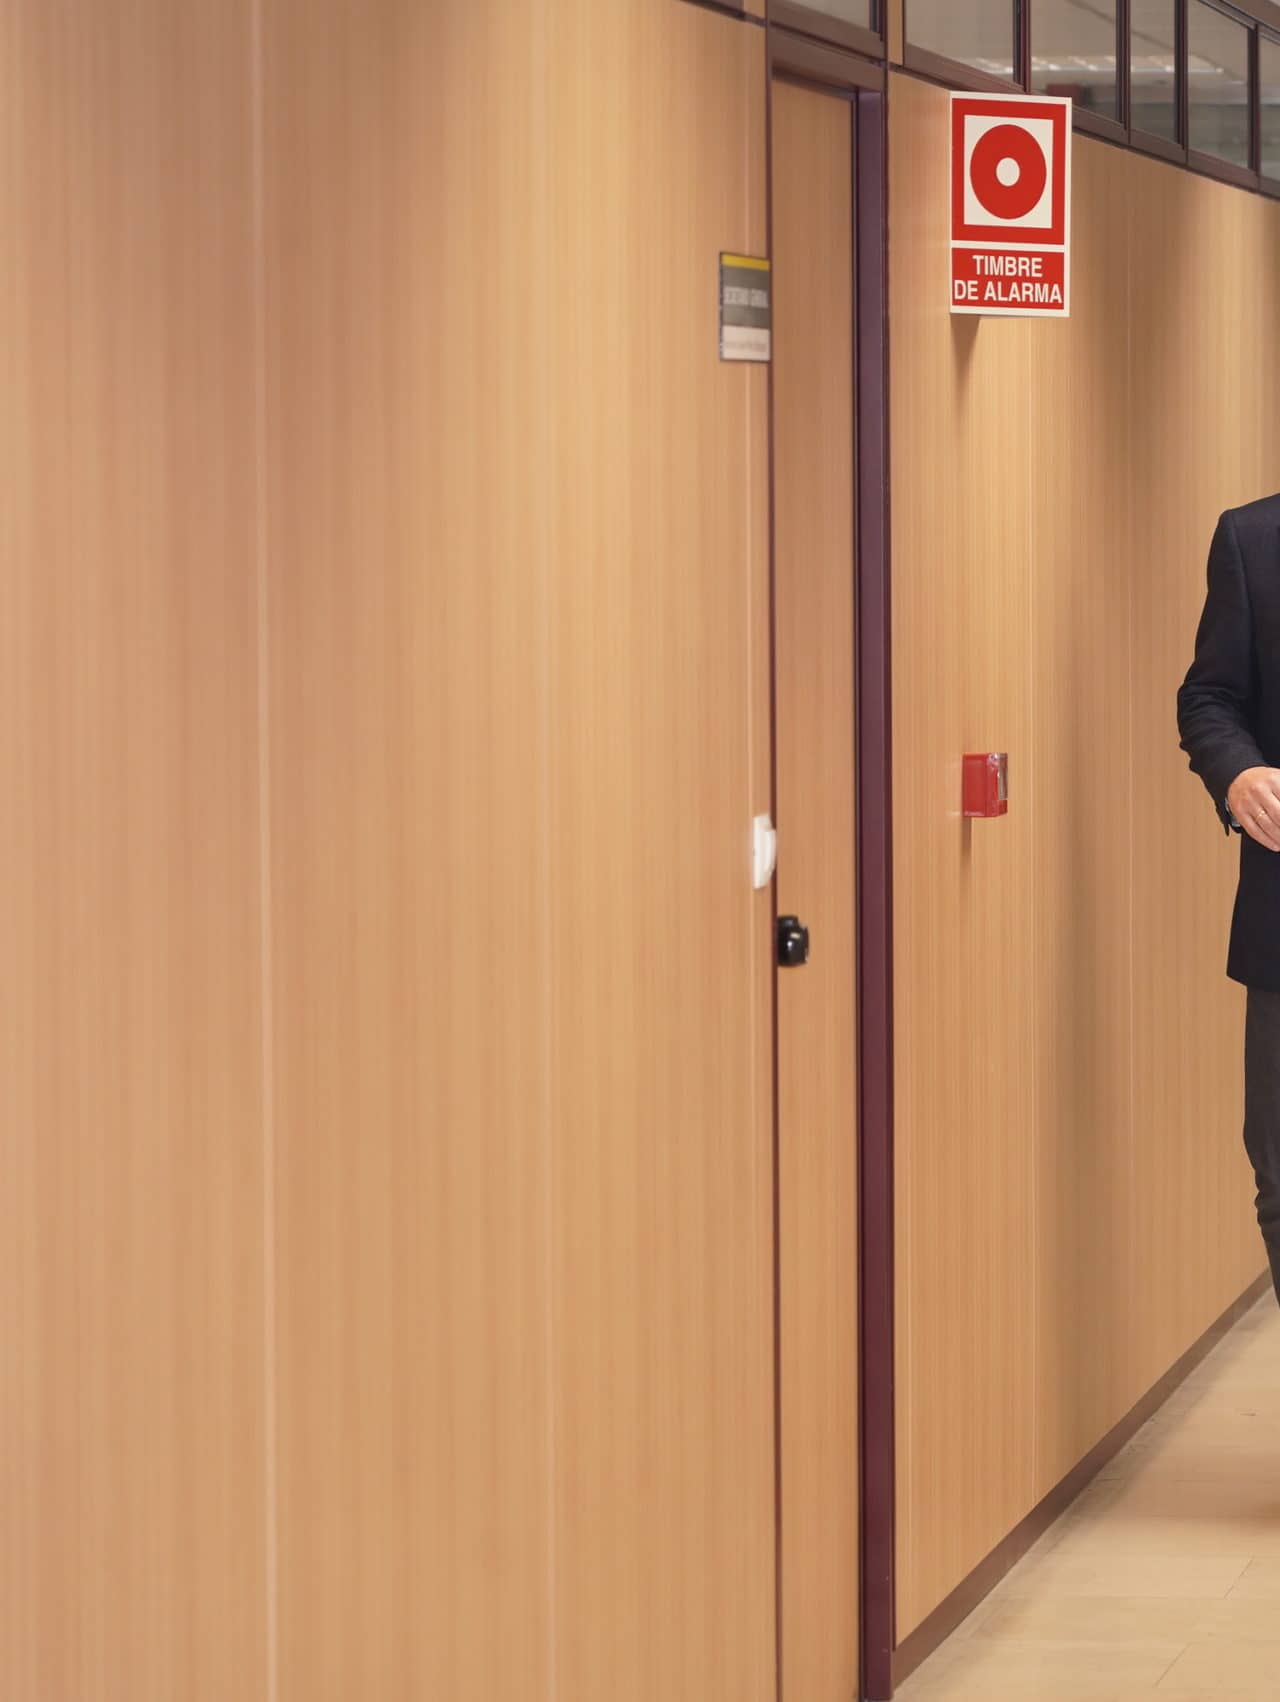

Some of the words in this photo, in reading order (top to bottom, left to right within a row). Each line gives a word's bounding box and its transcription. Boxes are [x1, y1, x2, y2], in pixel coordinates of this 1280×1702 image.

[972, 254, 1043, 278] TIMBRE
[954, 280, 979, 300] DE
[983, 281, 1062, 303] ALARMA
